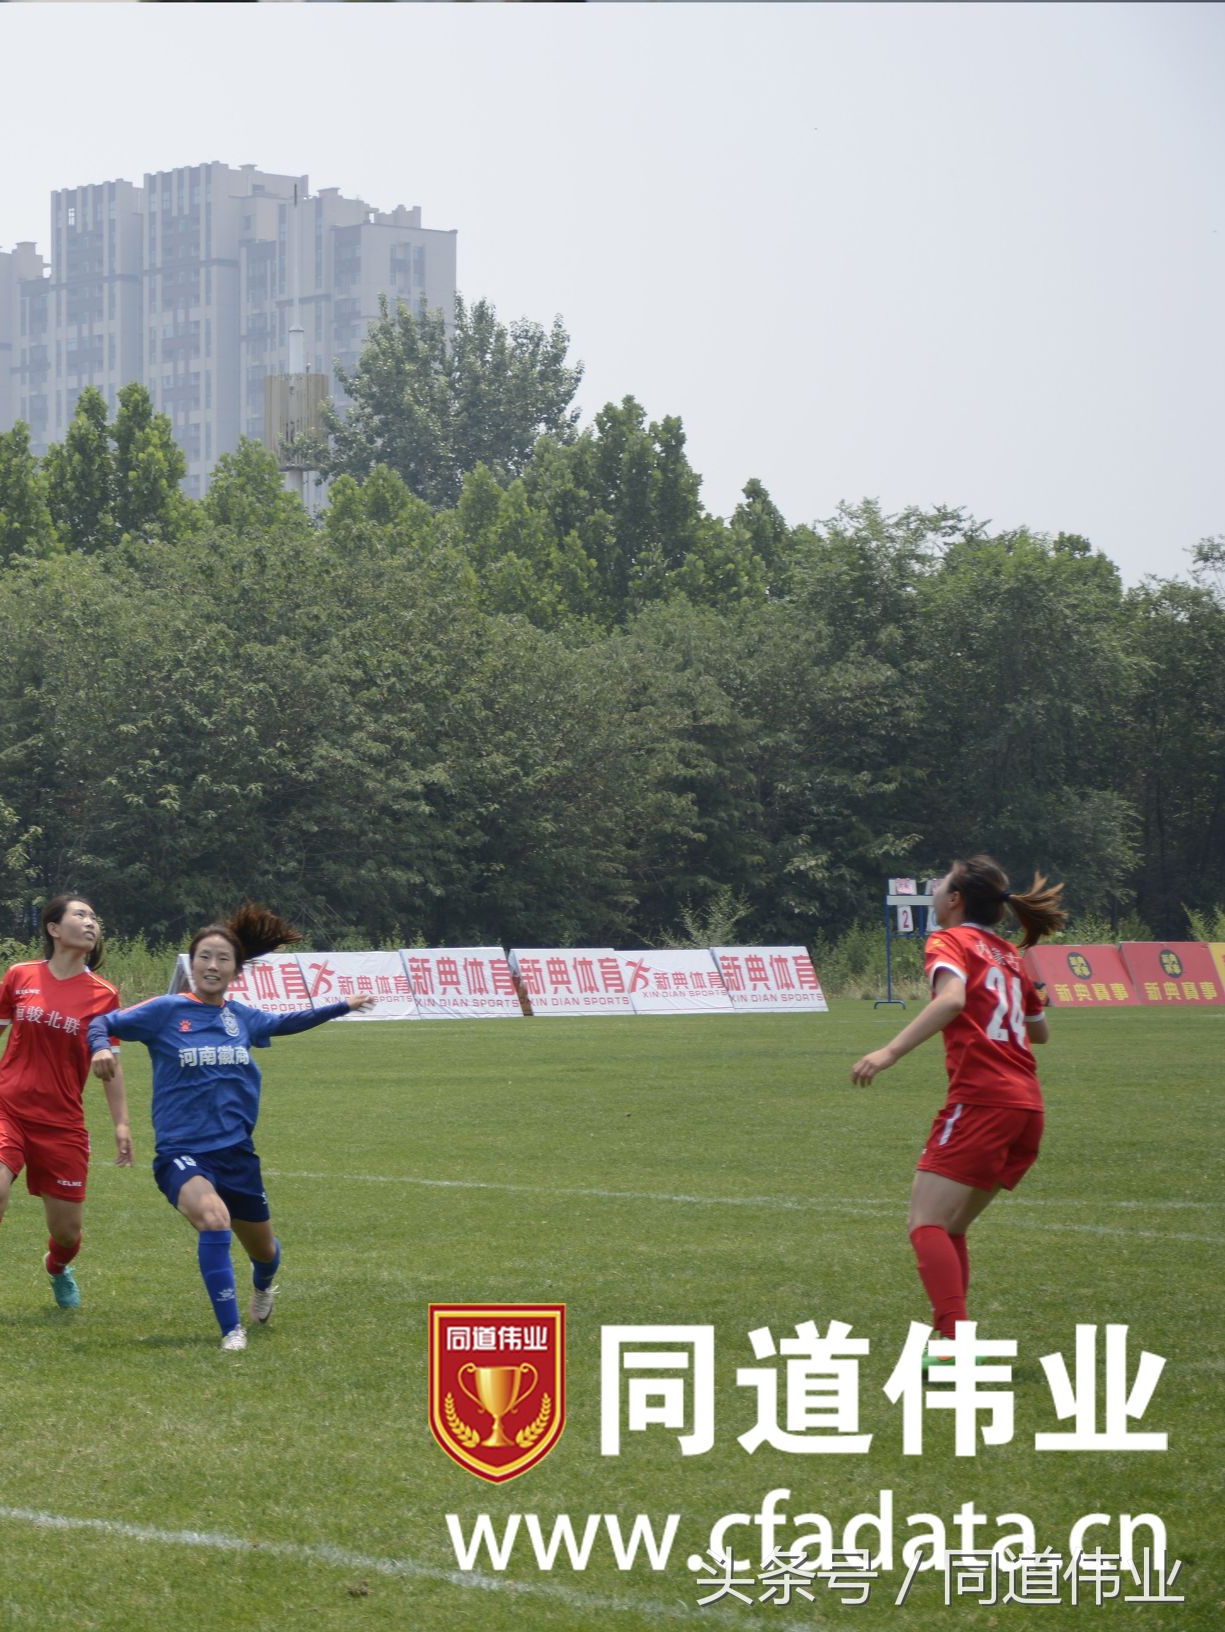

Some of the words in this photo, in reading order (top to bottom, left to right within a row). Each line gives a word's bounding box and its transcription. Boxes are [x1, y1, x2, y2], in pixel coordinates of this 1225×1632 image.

[902, 910, 910, 929] 2
[228, 962, 311, 1000] 典体育
[408, 957, 516, 995] 新典体育
[519, 957, 626, 994] 新典体育
[653, 971, 726, 991] 新典体育
[719, 954, 821, 991] 新典体育
[337, 974, 413, 996] 新典体育
[662, 990, 686, 998] DIAN
[689, 989, 727, 997] SPORTS
[259, 1003, 312, 1012] SPORTS
[416, 998, 435, 1007] XIN
[440, 998, 469, 1007] DIAN
[473, 998, 520, 1008] SPORTS
[529, 998, 548, 1006] XIN
[551, 997, 580, 1006] DIAN
[584, 996, 630, 1005] SPORTS
[730, 994, 747, 1003] XIN
[752, 994, 778, 1003] DIAN
[781, 993, 823, 1002] SPORTS
[985, 966, 1028, 1051] 24
